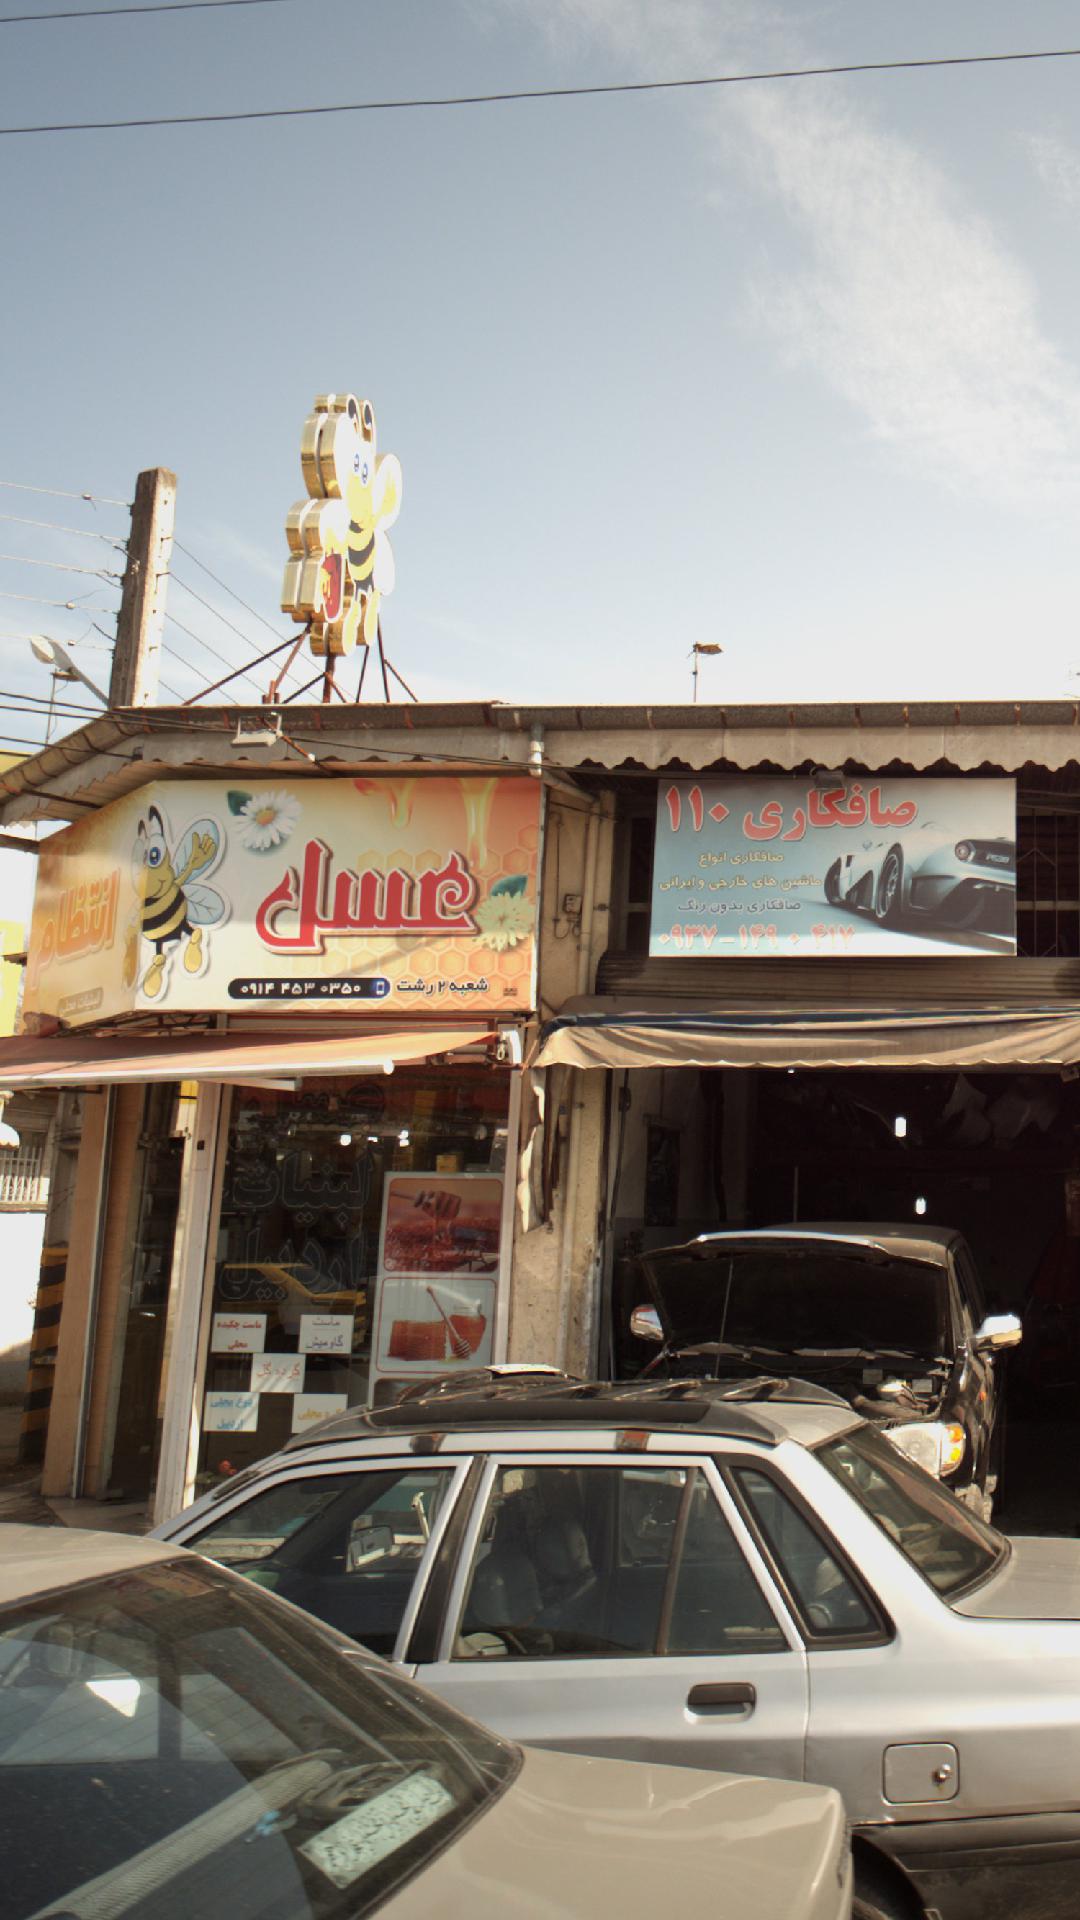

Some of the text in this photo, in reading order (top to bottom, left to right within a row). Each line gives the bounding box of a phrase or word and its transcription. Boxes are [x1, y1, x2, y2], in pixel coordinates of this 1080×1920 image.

[666, 784, 919, 841] صافکاری ۱۱۰
[698, 852, 785, 868] صافکاری انواع
[659, 873, 824, 892] ماشین های خارجی و ایرانی
[256, 838, 477, 954] عسل
[677, 899, 801, 914] صافکاری بدون رنگ
[30, 867, 119, 990] انتظام
[240, 982, 361, 995] ۰۹۱۴ ۴۵۳ ۰۳۵۰
[396, 978, 434, 995] رشت
[438, 979, 446, 993] ۲
[449, 977, 488, 996] شعبه
[232, 1150, 374, 1223] لبنیات
[312, 1316, 340, 1326] ماست
